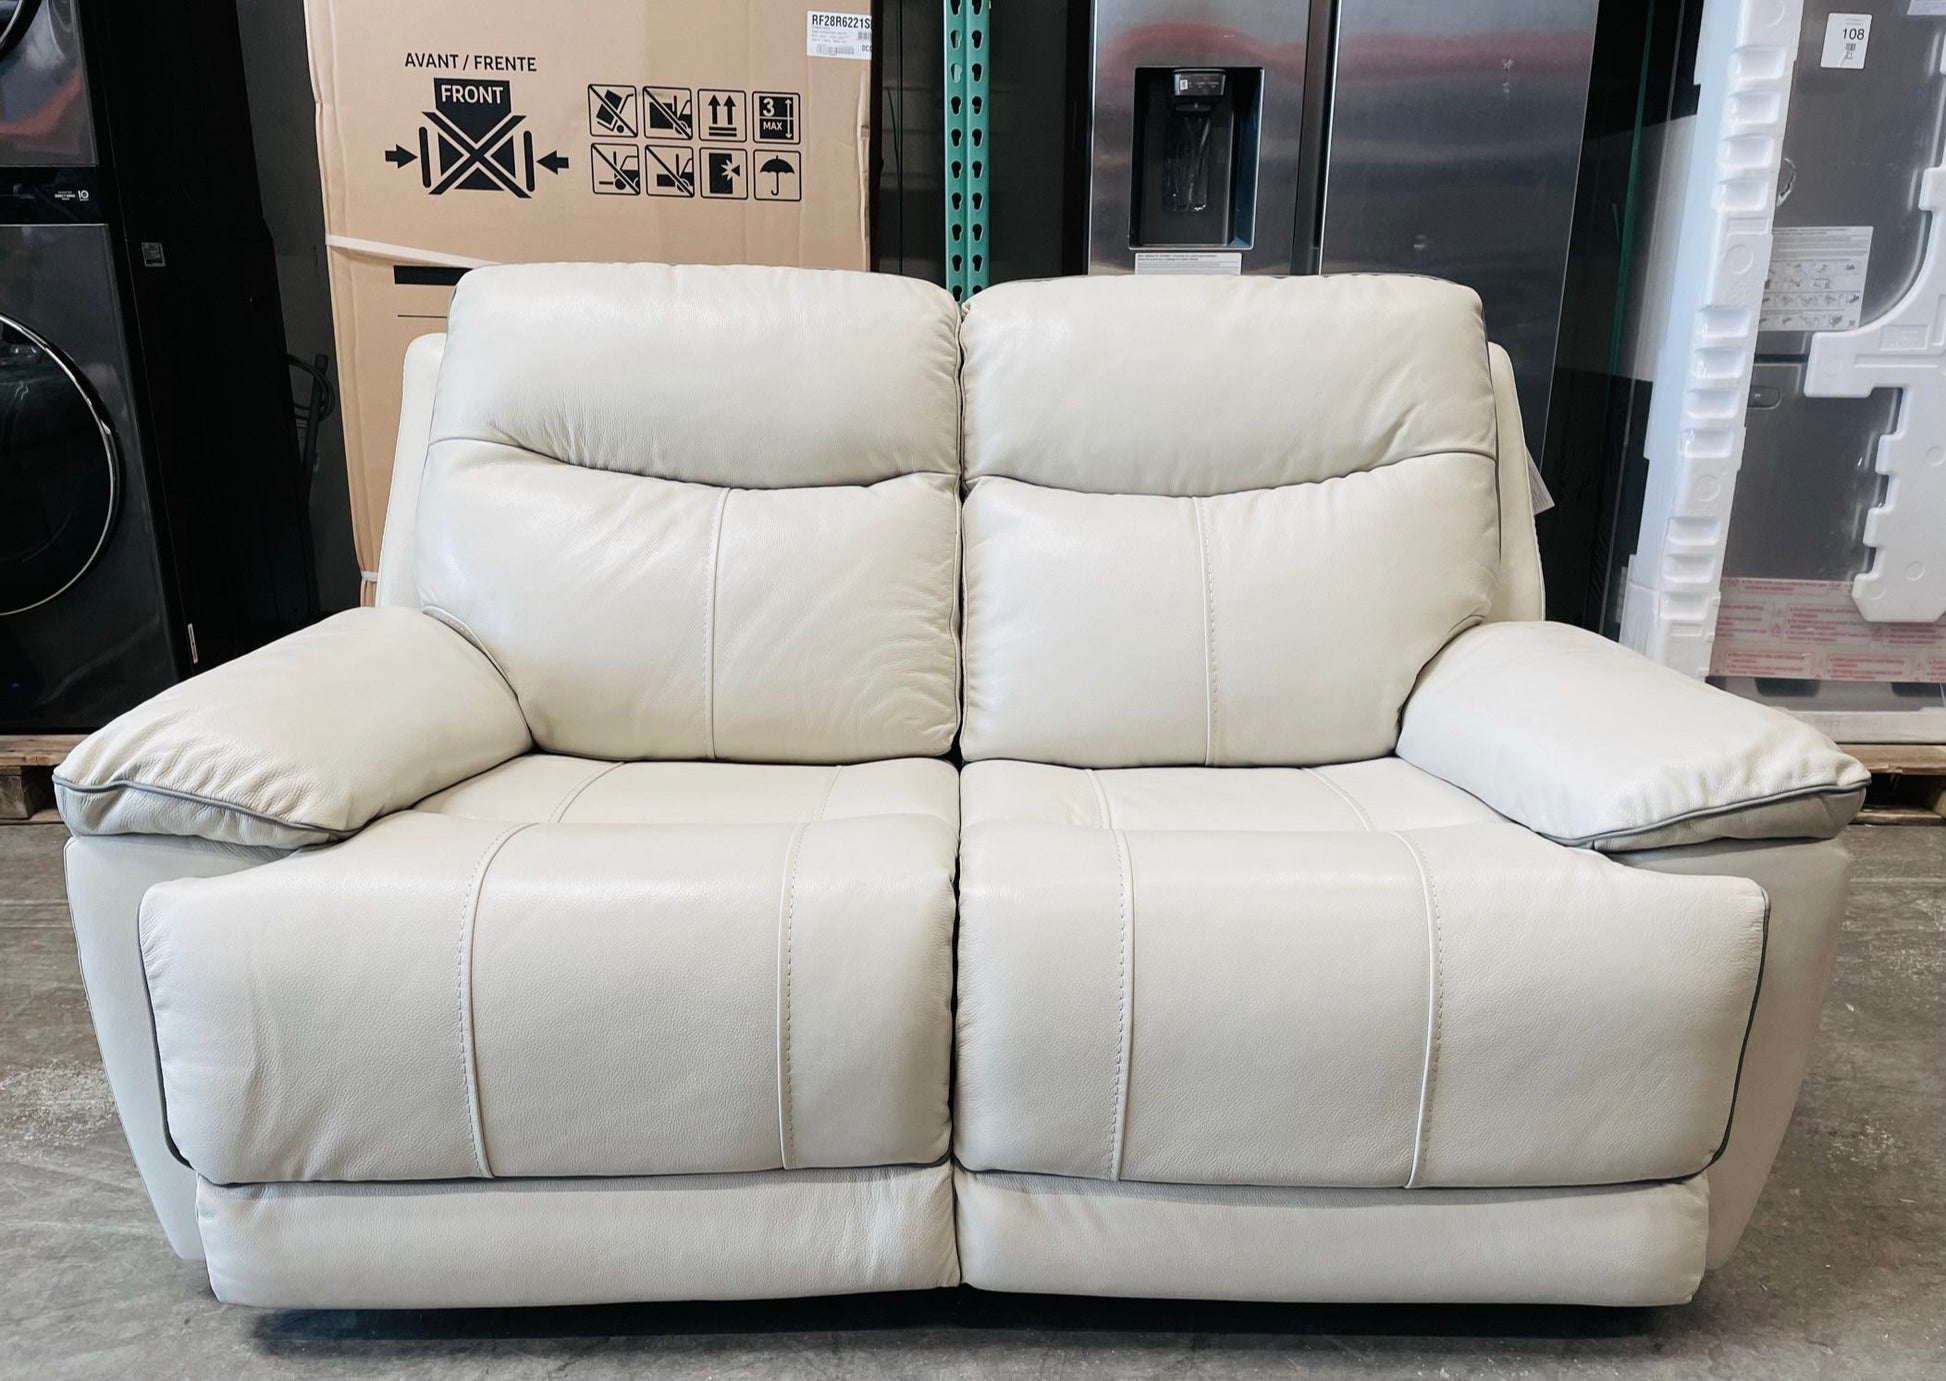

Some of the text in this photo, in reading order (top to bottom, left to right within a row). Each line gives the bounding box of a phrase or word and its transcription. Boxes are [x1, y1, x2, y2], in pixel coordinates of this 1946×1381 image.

[812, 14, 872, 29] RF28R6221S
[1843, 28, 1865, 40] 108
[404, 52, 459, 69] AVANT
[473, 55, 537, 72] FRENTE
[441, 85, 503, 104] FRONT
[762, 97, 775, 117] 3
[763, 121, 783, 130] MAX
